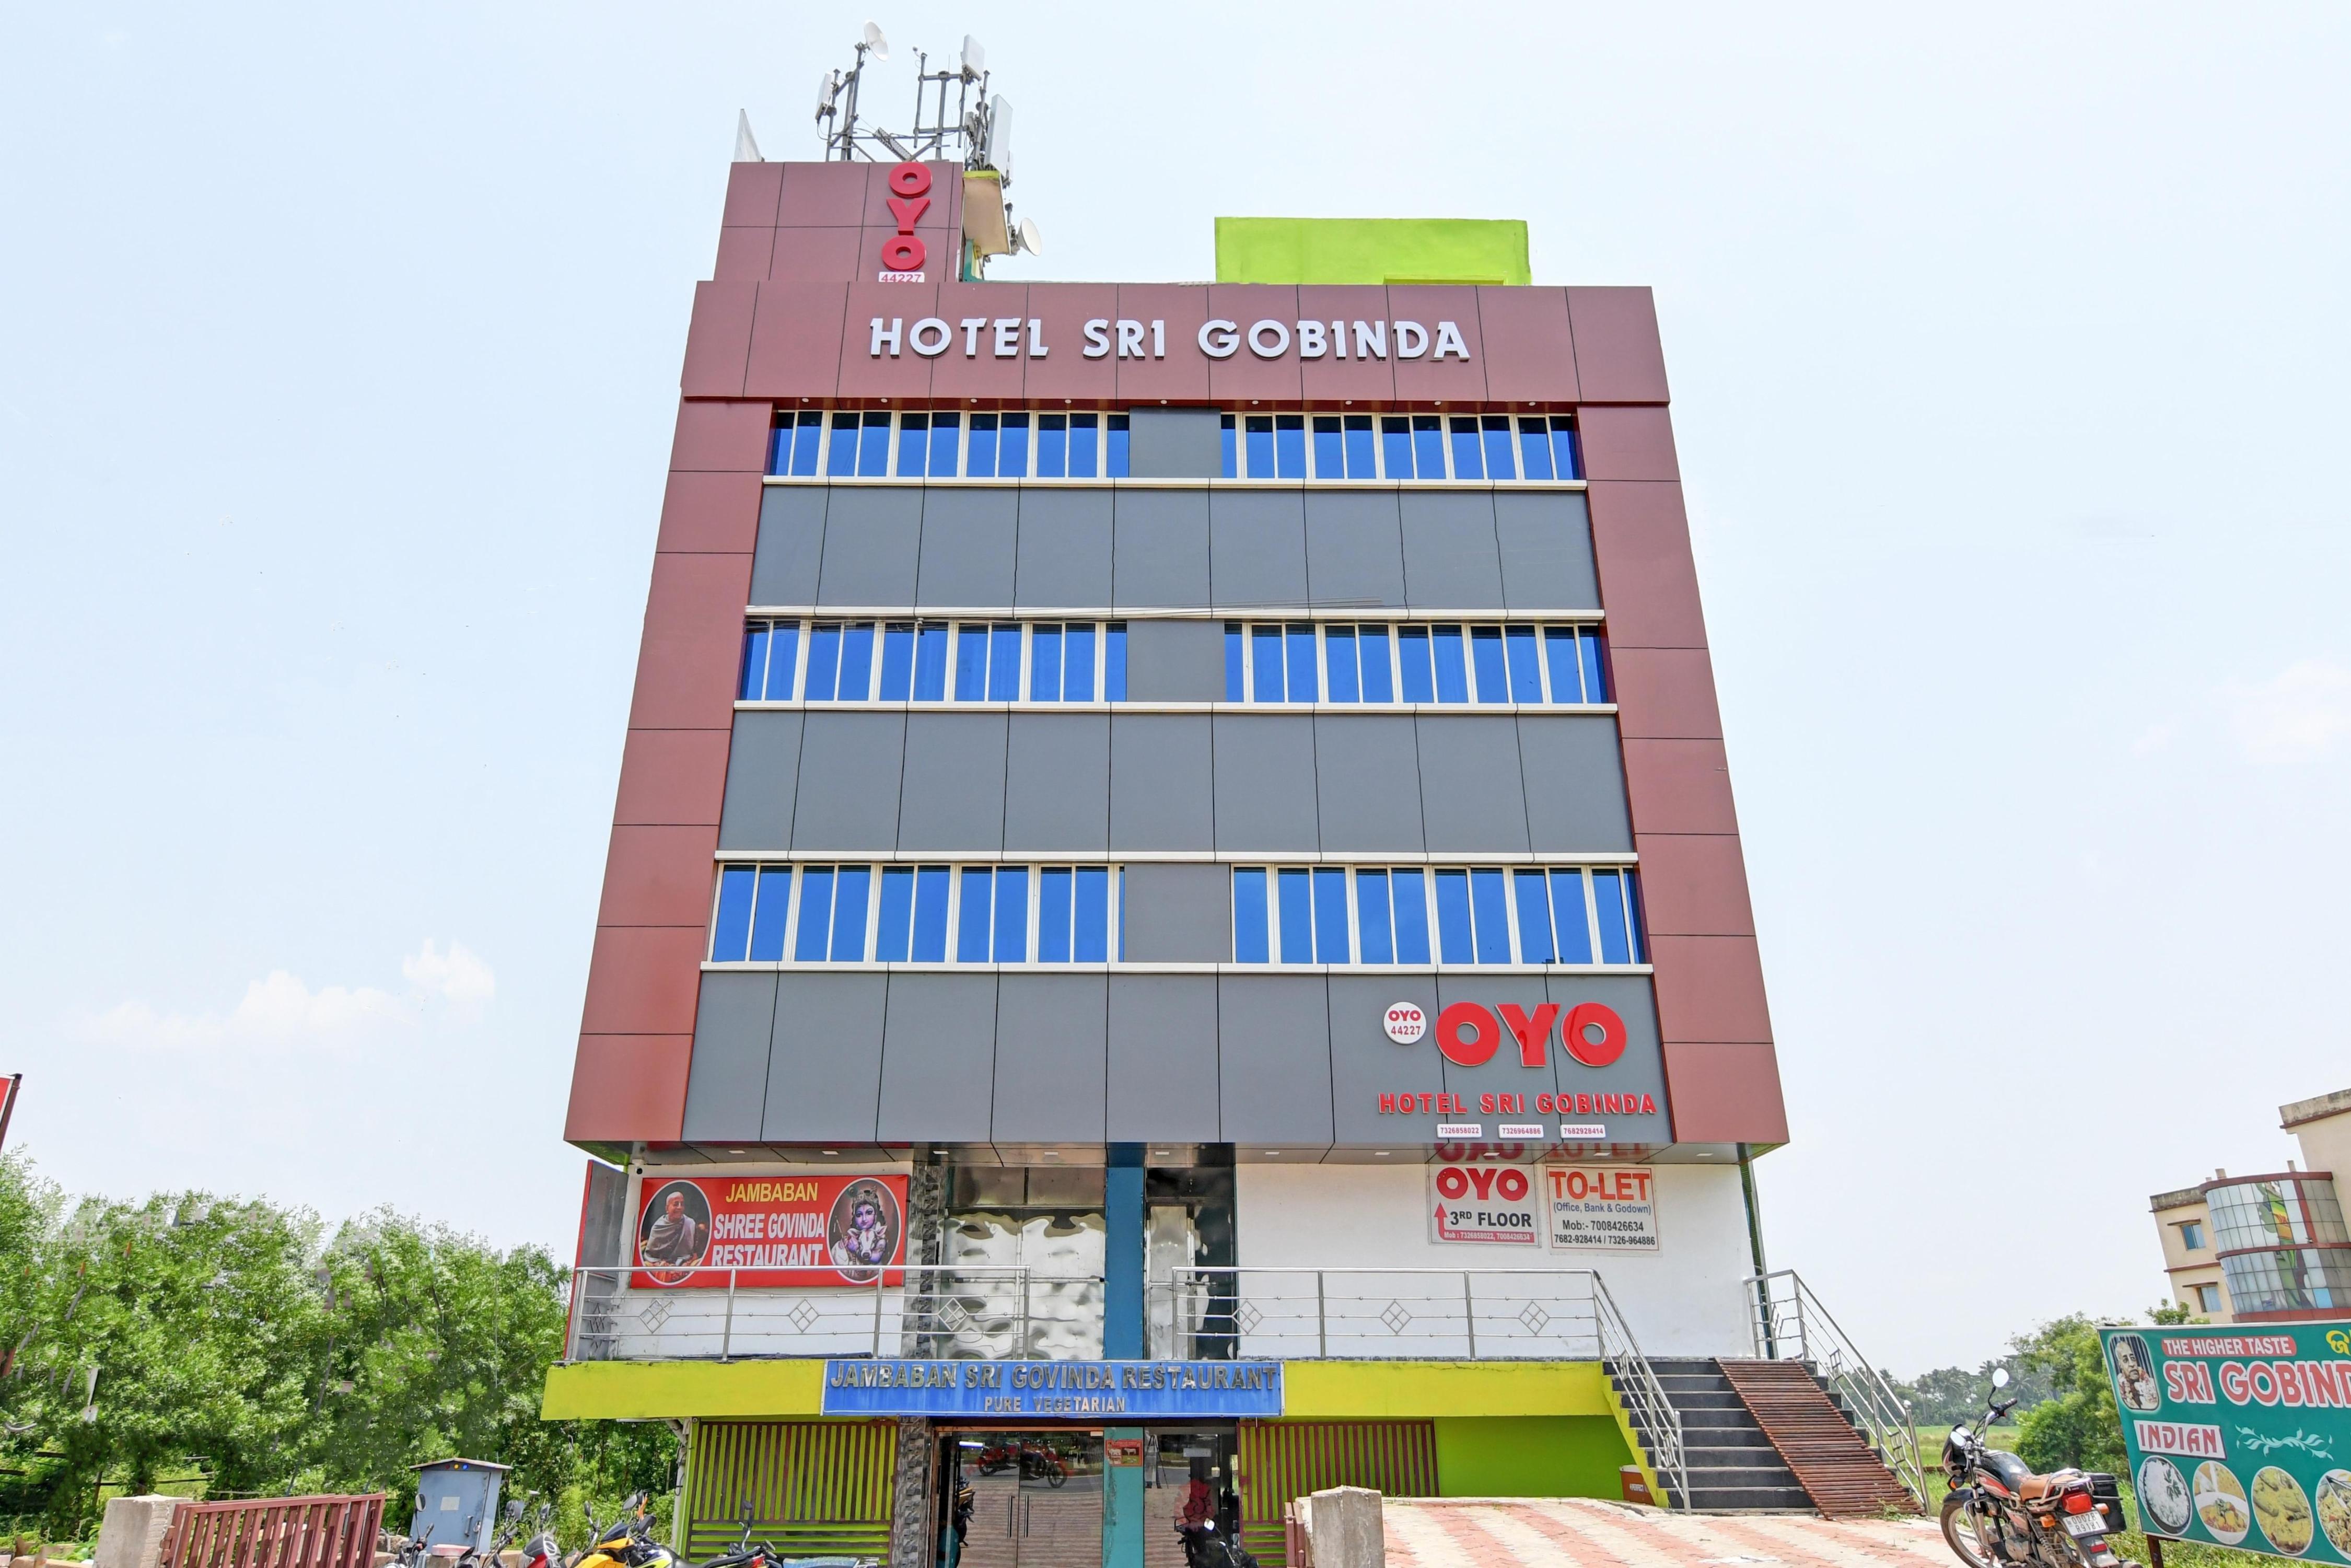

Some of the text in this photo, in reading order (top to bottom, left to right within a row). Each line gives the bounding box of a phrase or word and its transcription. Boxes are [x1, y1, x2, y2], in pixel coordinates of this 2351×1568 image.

[881, 162, 932, 272] OYO
[881, 274, 921, 282] 44227
[870, 318, 1470, 362] HOTEL SRI GOBINDA
[1389, 1010, 1421, 1021] OYO
[1391, 1026, 1421, 1035] 44227
[1435, 1002, 1627, 1067] OYO
[1378, 1093, 1656, 1114] HOTEL SRI GOBINDA
[726, 1182, 818, 1202] JAMBABAN
[1436, 1167, 1528, 1201] OYO
[1549, 1171, 1650, 1201] TO-LET
[1450, 1211, 1532, 1227] 3RD FLOOR
[1554, 1202, 1651, 1215] (Office, Bank & Godown)
[714, 1213, 825, 1239] SHREE GOVINDA
[1590, 1220, 1644, 1232] 7008426634
[1554, 1234, 1602, 1244] 7682-928414
[1608, 1235, 1655, 1245] 7326-964886
[711, 1244, 823, 1267] RESTAURANT
[2164, 1337, 2292, 1355] THE HIGHER TASTE
[831, 1364, 1276, 1390] JAMBABAN SRI GOVINDA RESTAURANT
[2163, 1361, 2216, 1404] SRI
[984, 1397, 1126, 1412] PURE VEGETARIAN
[2138, 1423, 2218, 1455] INDIAN
